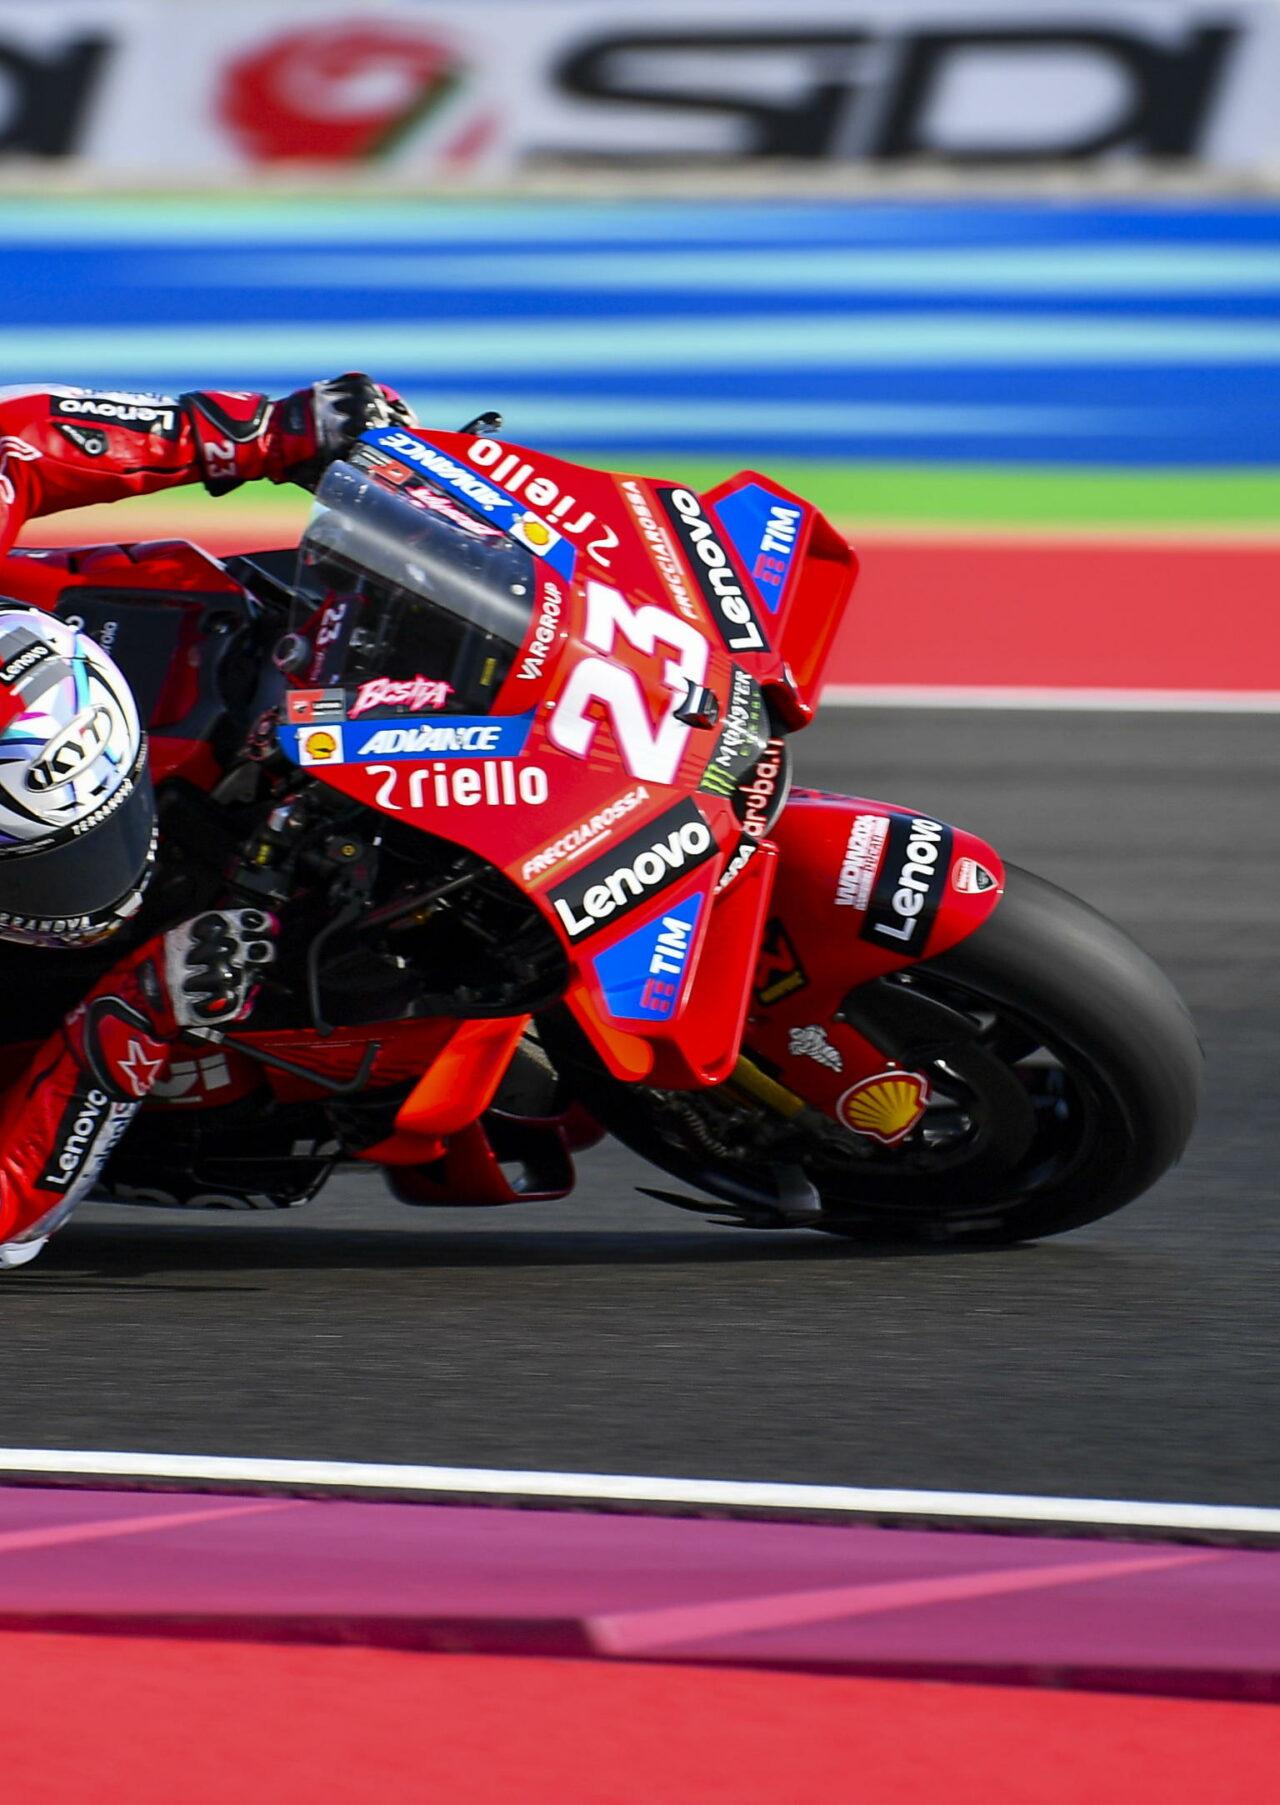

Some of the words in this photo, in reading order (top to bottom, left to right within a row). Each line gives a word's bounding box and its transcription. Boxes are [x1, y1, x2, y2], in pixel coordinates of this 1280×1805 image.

[59, 399, 175, 431] Lenovo
[378, 432, 513, 511] ADVANCE
[467, 438, 596, 534] riello
[621, 481, 698, 620] FRECCIAROSSA
[671, 488, 764, 650] Lenovo
[760, 506, 801, 554] TIM
[517, 581, 562, 680] VARGROUP
[548, 577, 710, 786] 23
[715, 670, 753, 767] MONSTER
[31, 714, 106, 789] KYT
[357, 724, 503, 756] ADVANCE
[408, 760, 549, 808] riello
[522, 785, 651, 881] FRECCIAROSSA
[554, 822, 711, 936] Lenovo
[874, 818, 944, 942] Lenovo
[47, 1089, 108, 1185] Lenovo
